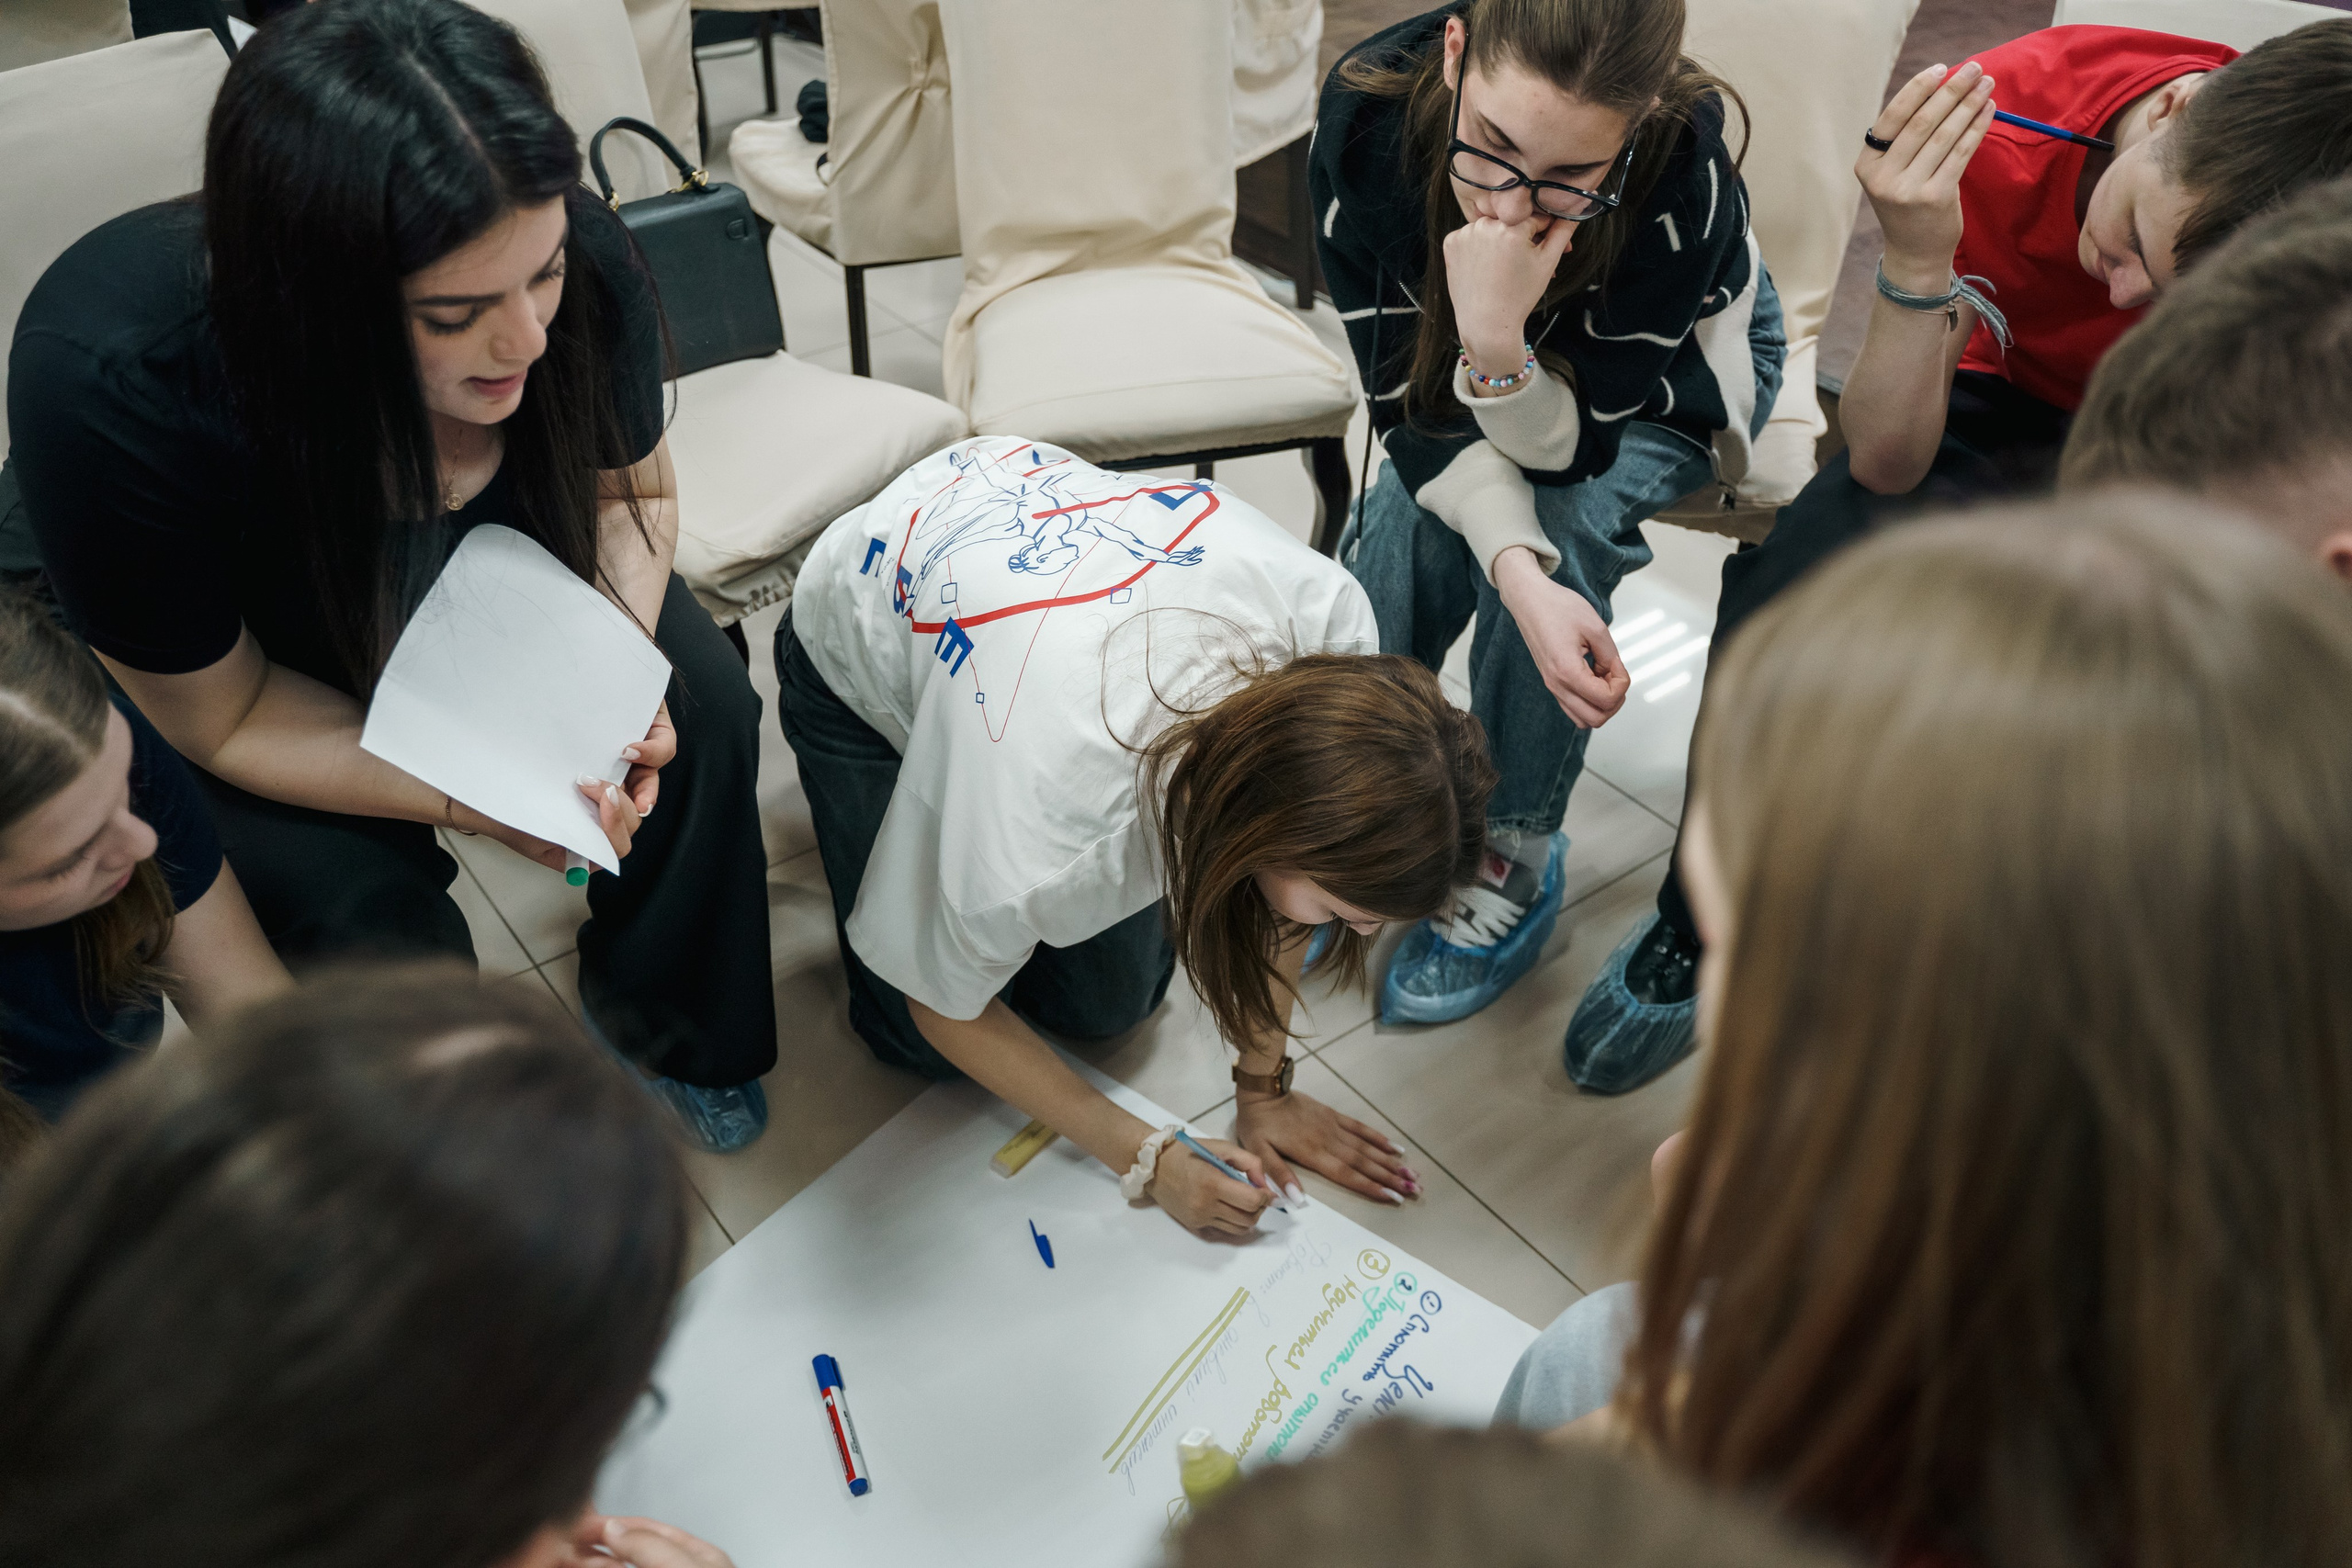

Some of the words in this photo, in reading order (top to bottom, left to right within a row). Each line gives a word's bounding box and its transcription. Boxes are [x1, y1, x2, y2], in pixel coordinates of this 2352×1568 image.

[1284, 1273, 1363, 1371] Научиться
[1320, 1285, 1406, 1385] Поделиться
[1232, 1344, 1293, 1462] работат
